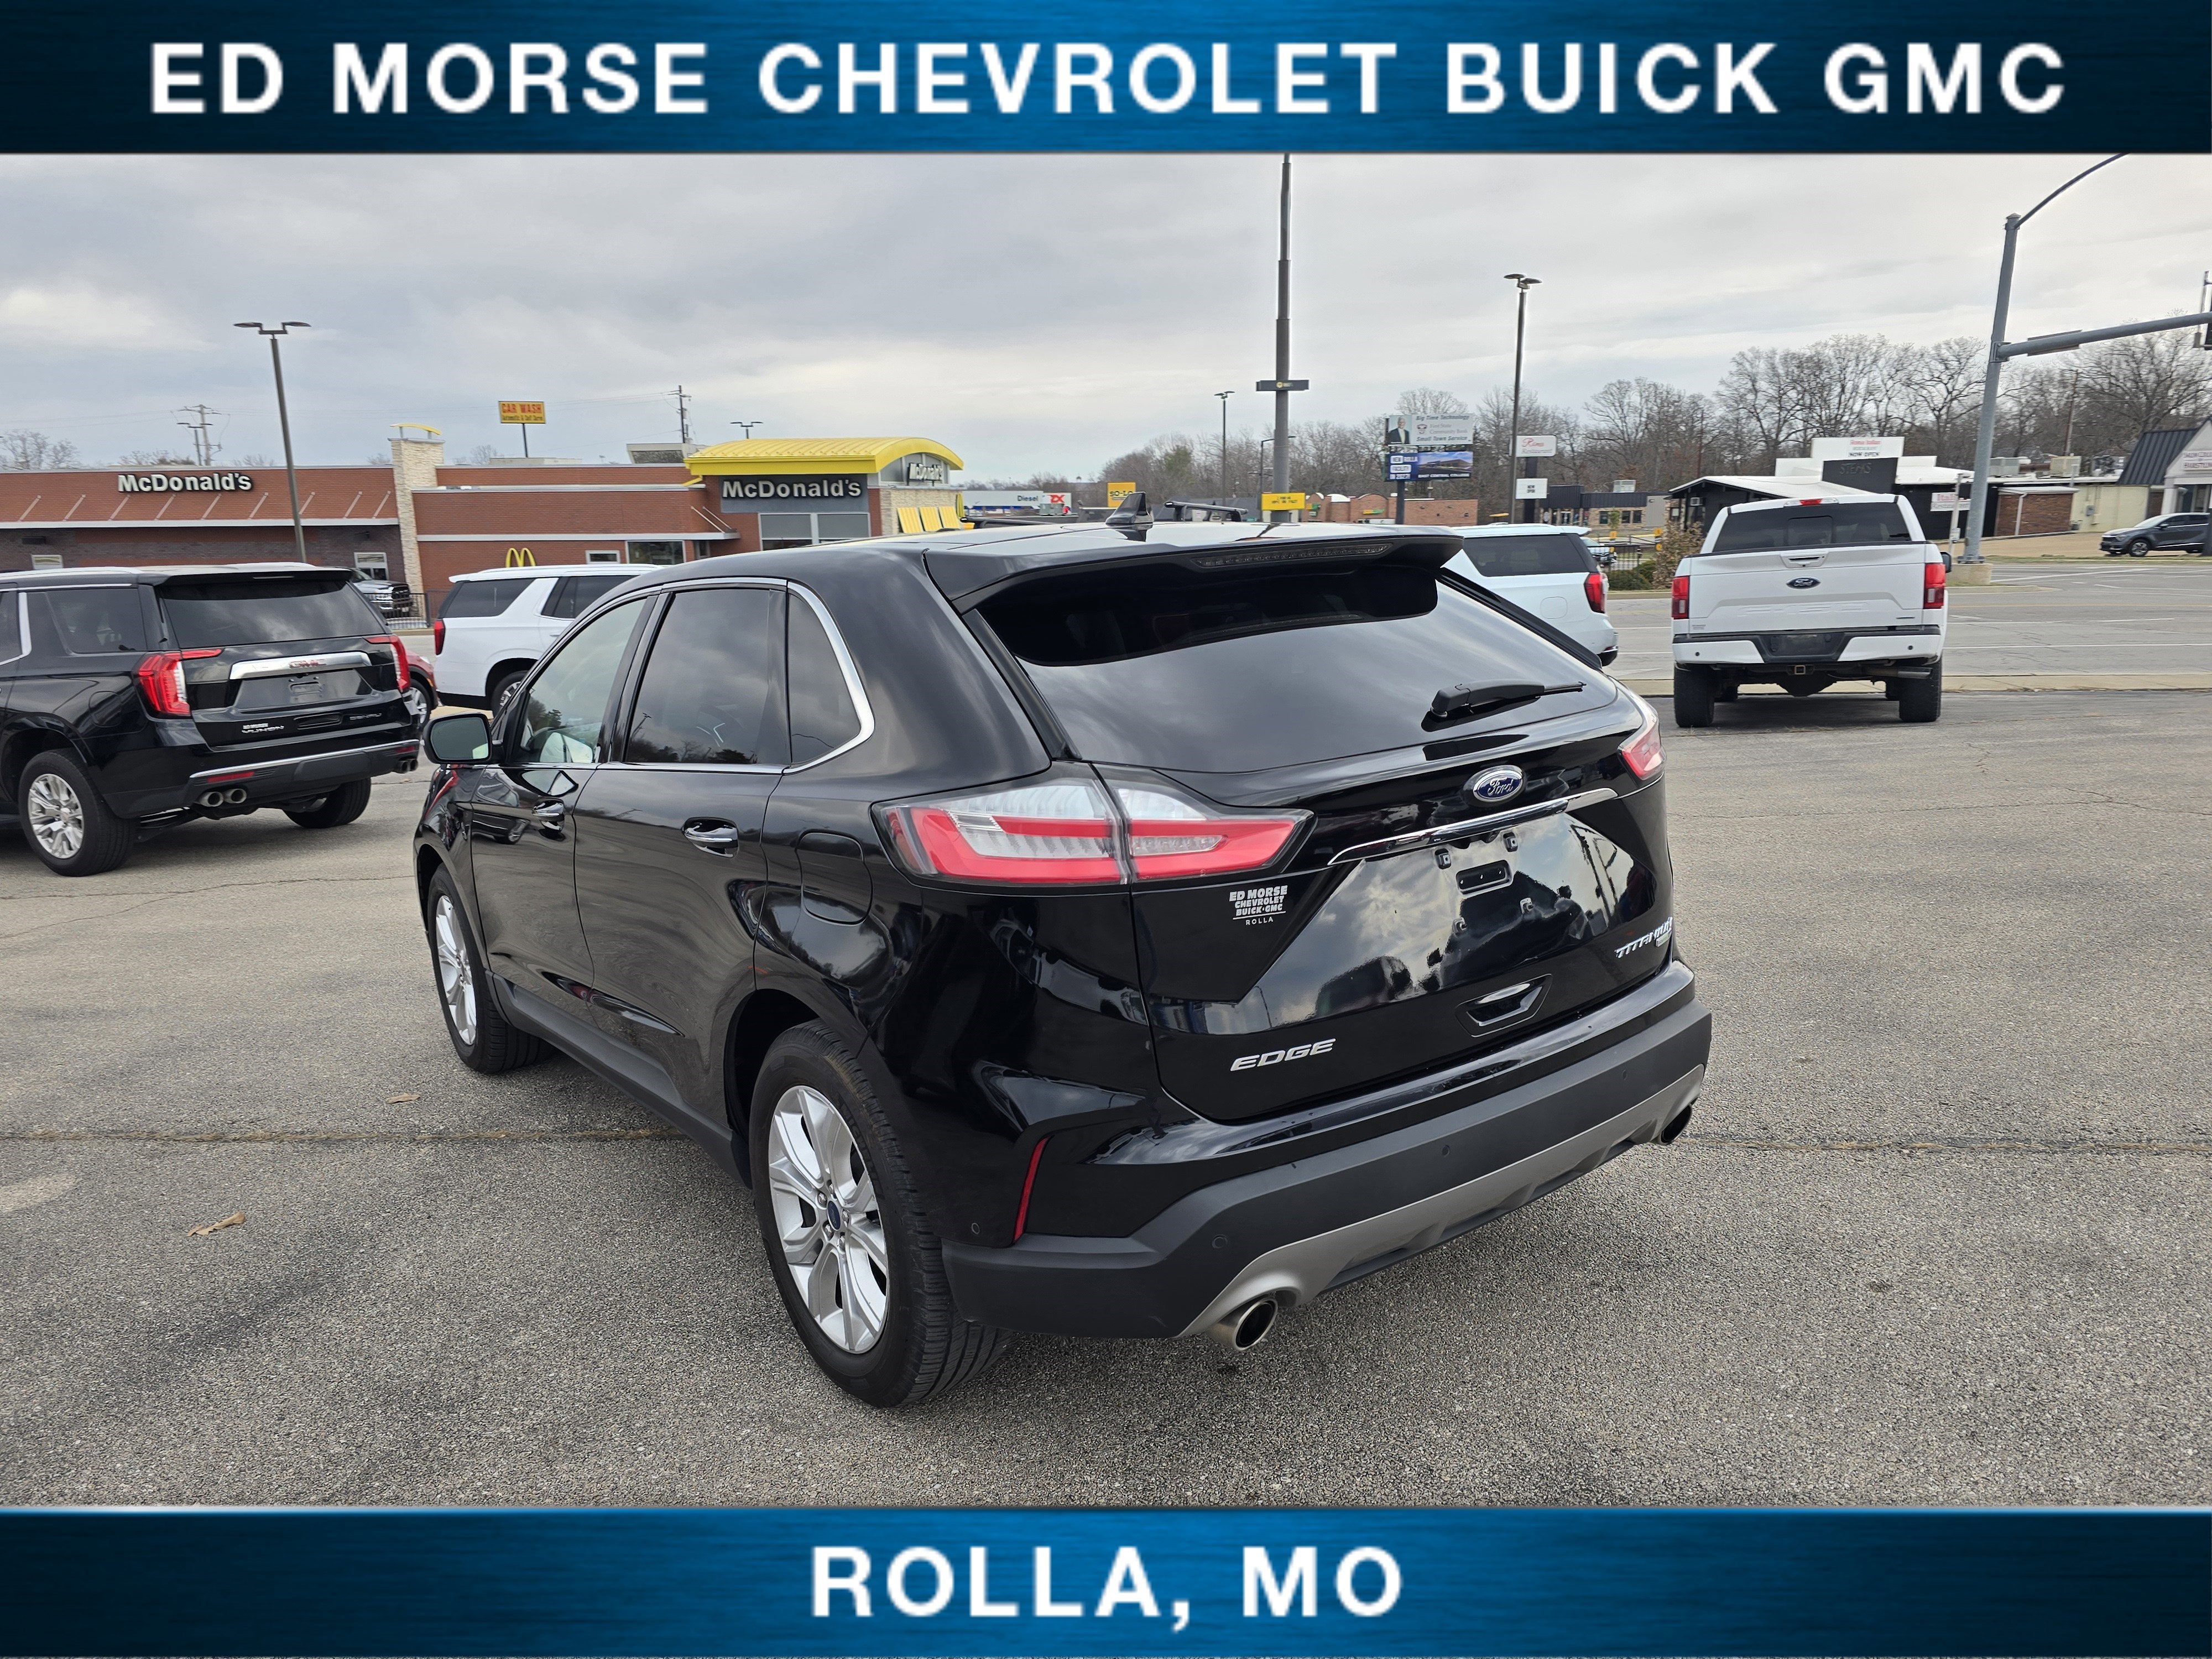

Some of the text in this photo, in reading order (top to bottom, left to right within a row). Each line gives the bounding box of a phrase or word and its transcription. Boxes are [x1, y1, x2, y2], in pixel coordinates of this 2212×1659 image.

[118, 473, 252, 492] McDonald's
[722, 479, 861, 497] McDonald's
[289, 659, 327, 669] GMC
[1488, 776, 1514, 796] Ford
[1229, 885, 1288, 901] ED MORSE
[1234, 895, 1285, 909] CHEVROLET
[1246, 916, 1274, 925] ROLLA
[1230, 1038, 1336, 1071] EDGE
